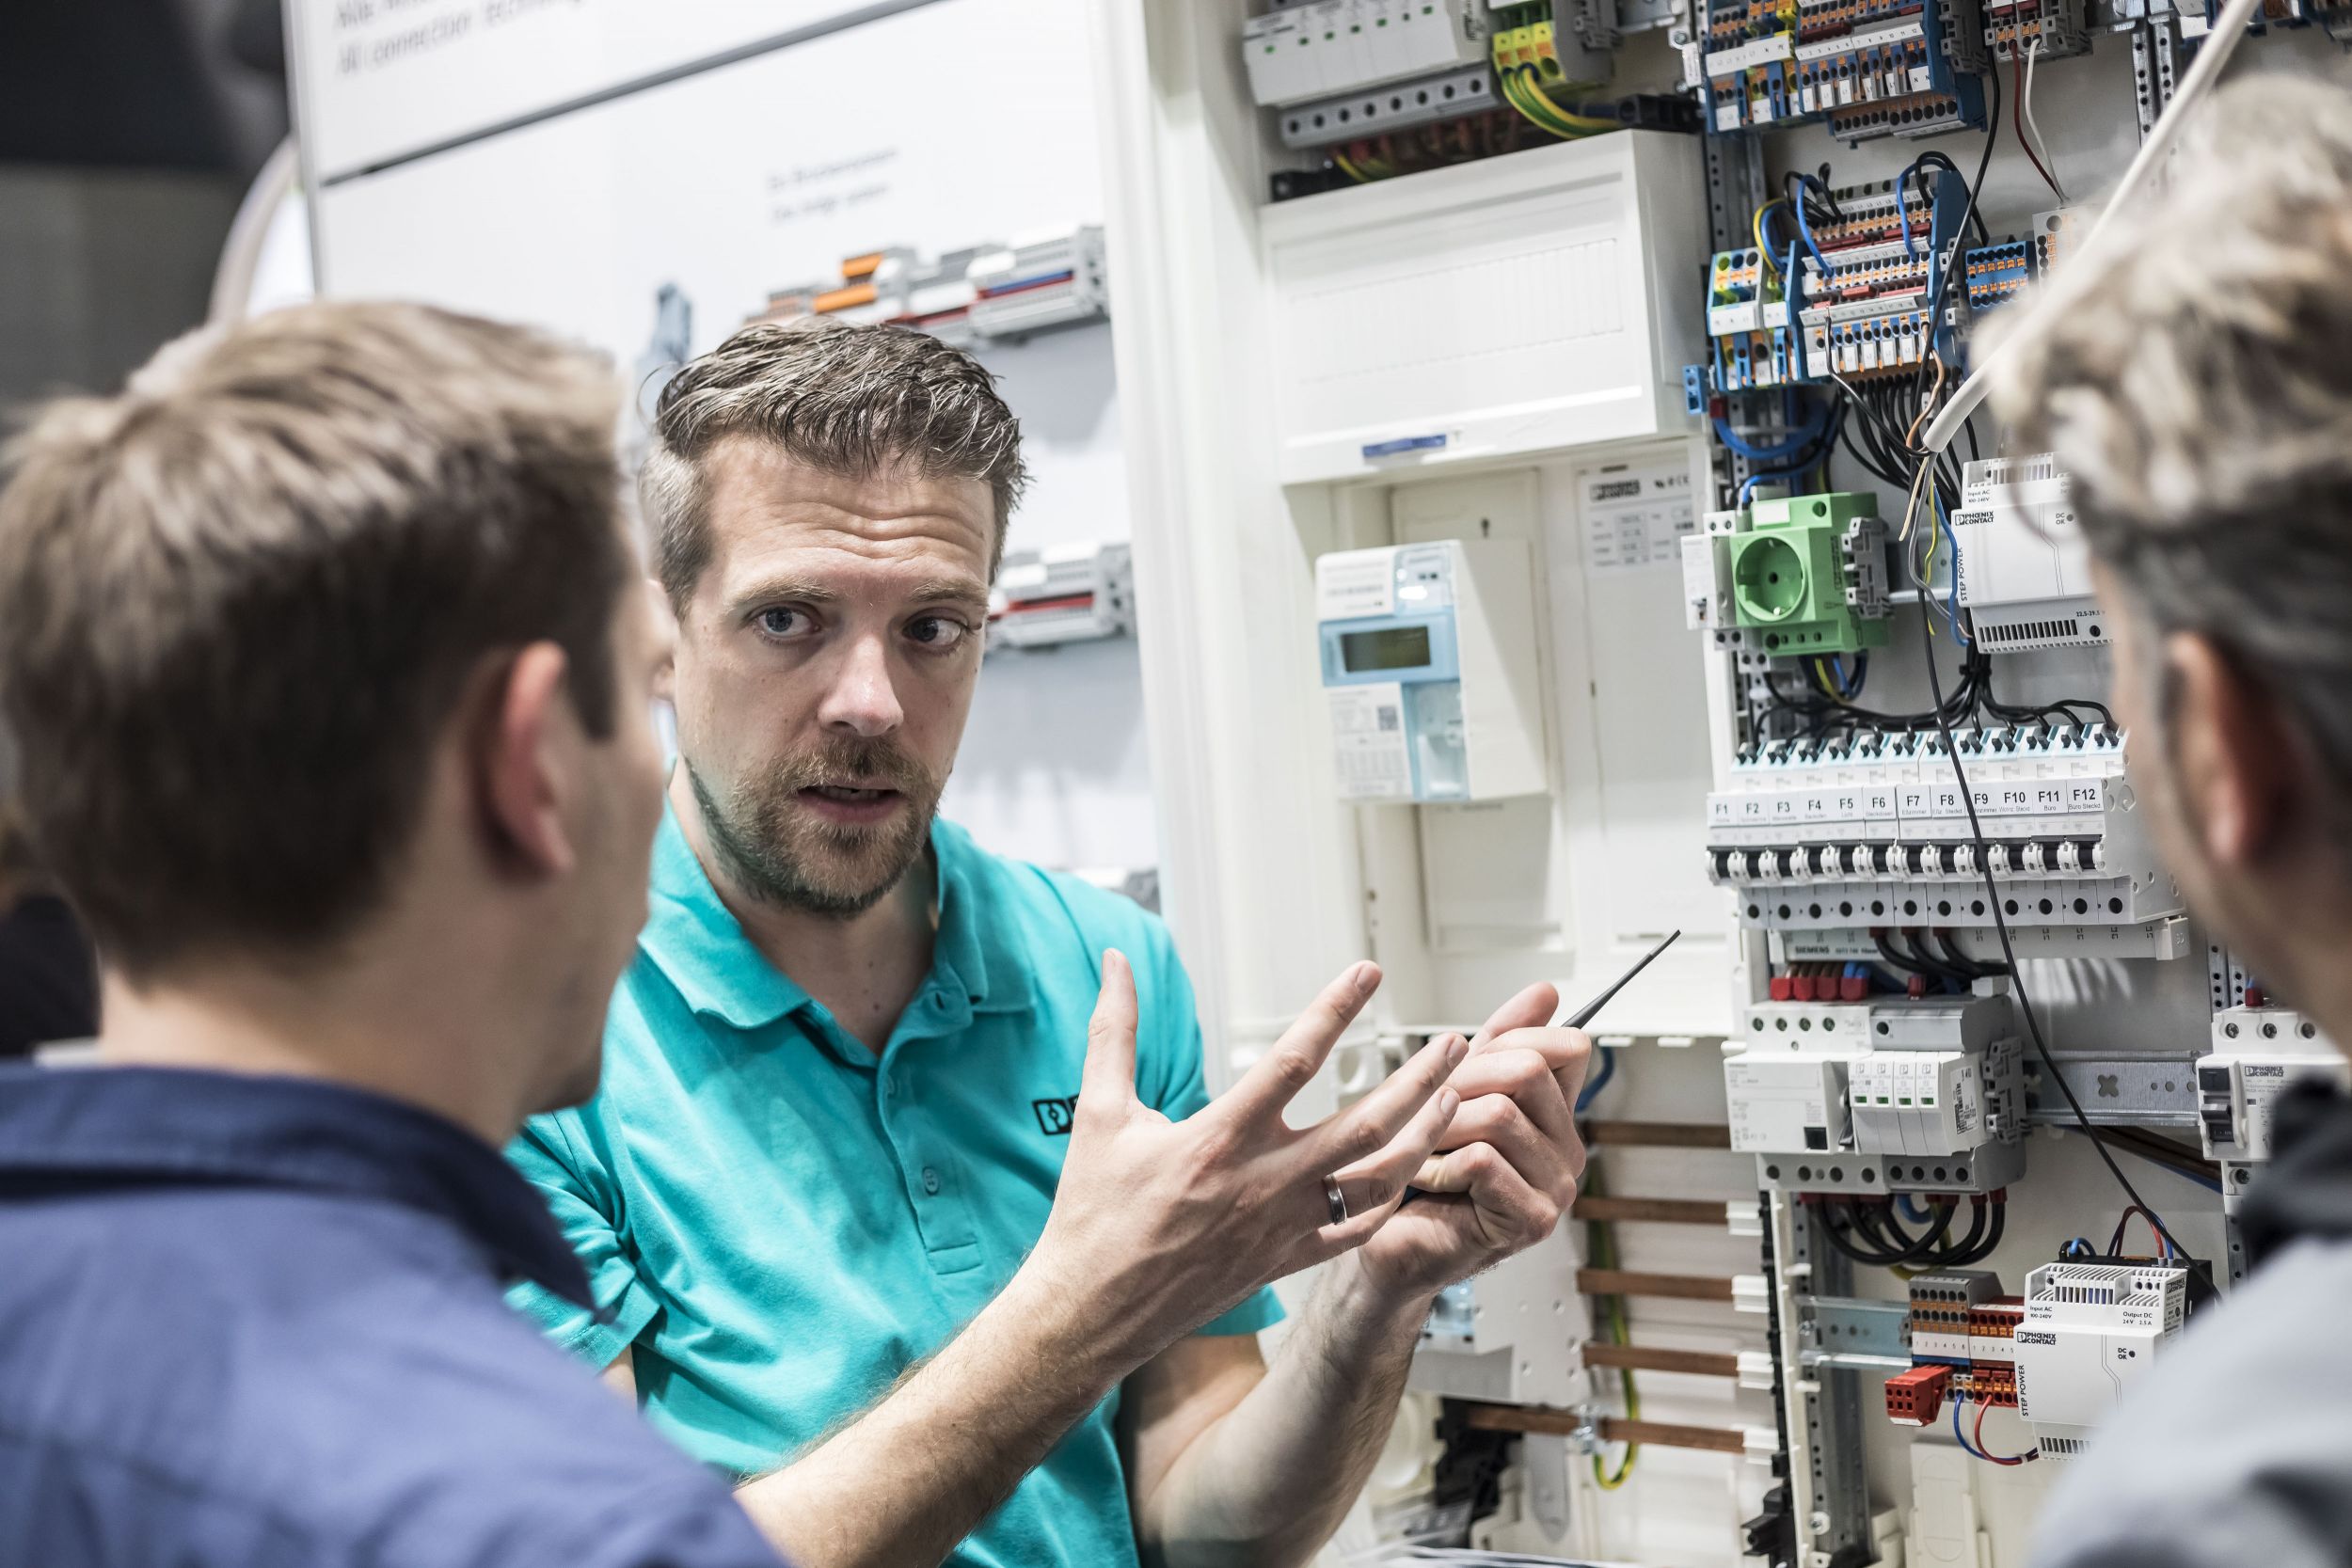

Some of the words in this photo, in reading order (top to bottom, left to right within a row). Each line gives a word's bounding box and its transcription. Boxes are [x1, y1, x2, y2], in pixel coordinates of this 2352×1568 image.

[1959, 581, 1968, 601] STEP
[1940, 794, 1955, 806] F8
[1974, 793, 1989, 805] F9
[2004, 791, 2026, 803] F10
[2038, 790, 2059, 802] F11
[2073, 788, 2096, 800] F12
[1808, 800, 1821, 811] F4
[1839, 798, 1853, 809] F5
[1872, 797, 1885, 808] F6
[1906, 795, 1920, 806] F7
[1716, 803, 1727, 814] F1
[1746, 802, 1759, 814] F2
[1777, 801, 1790, 813] F3
